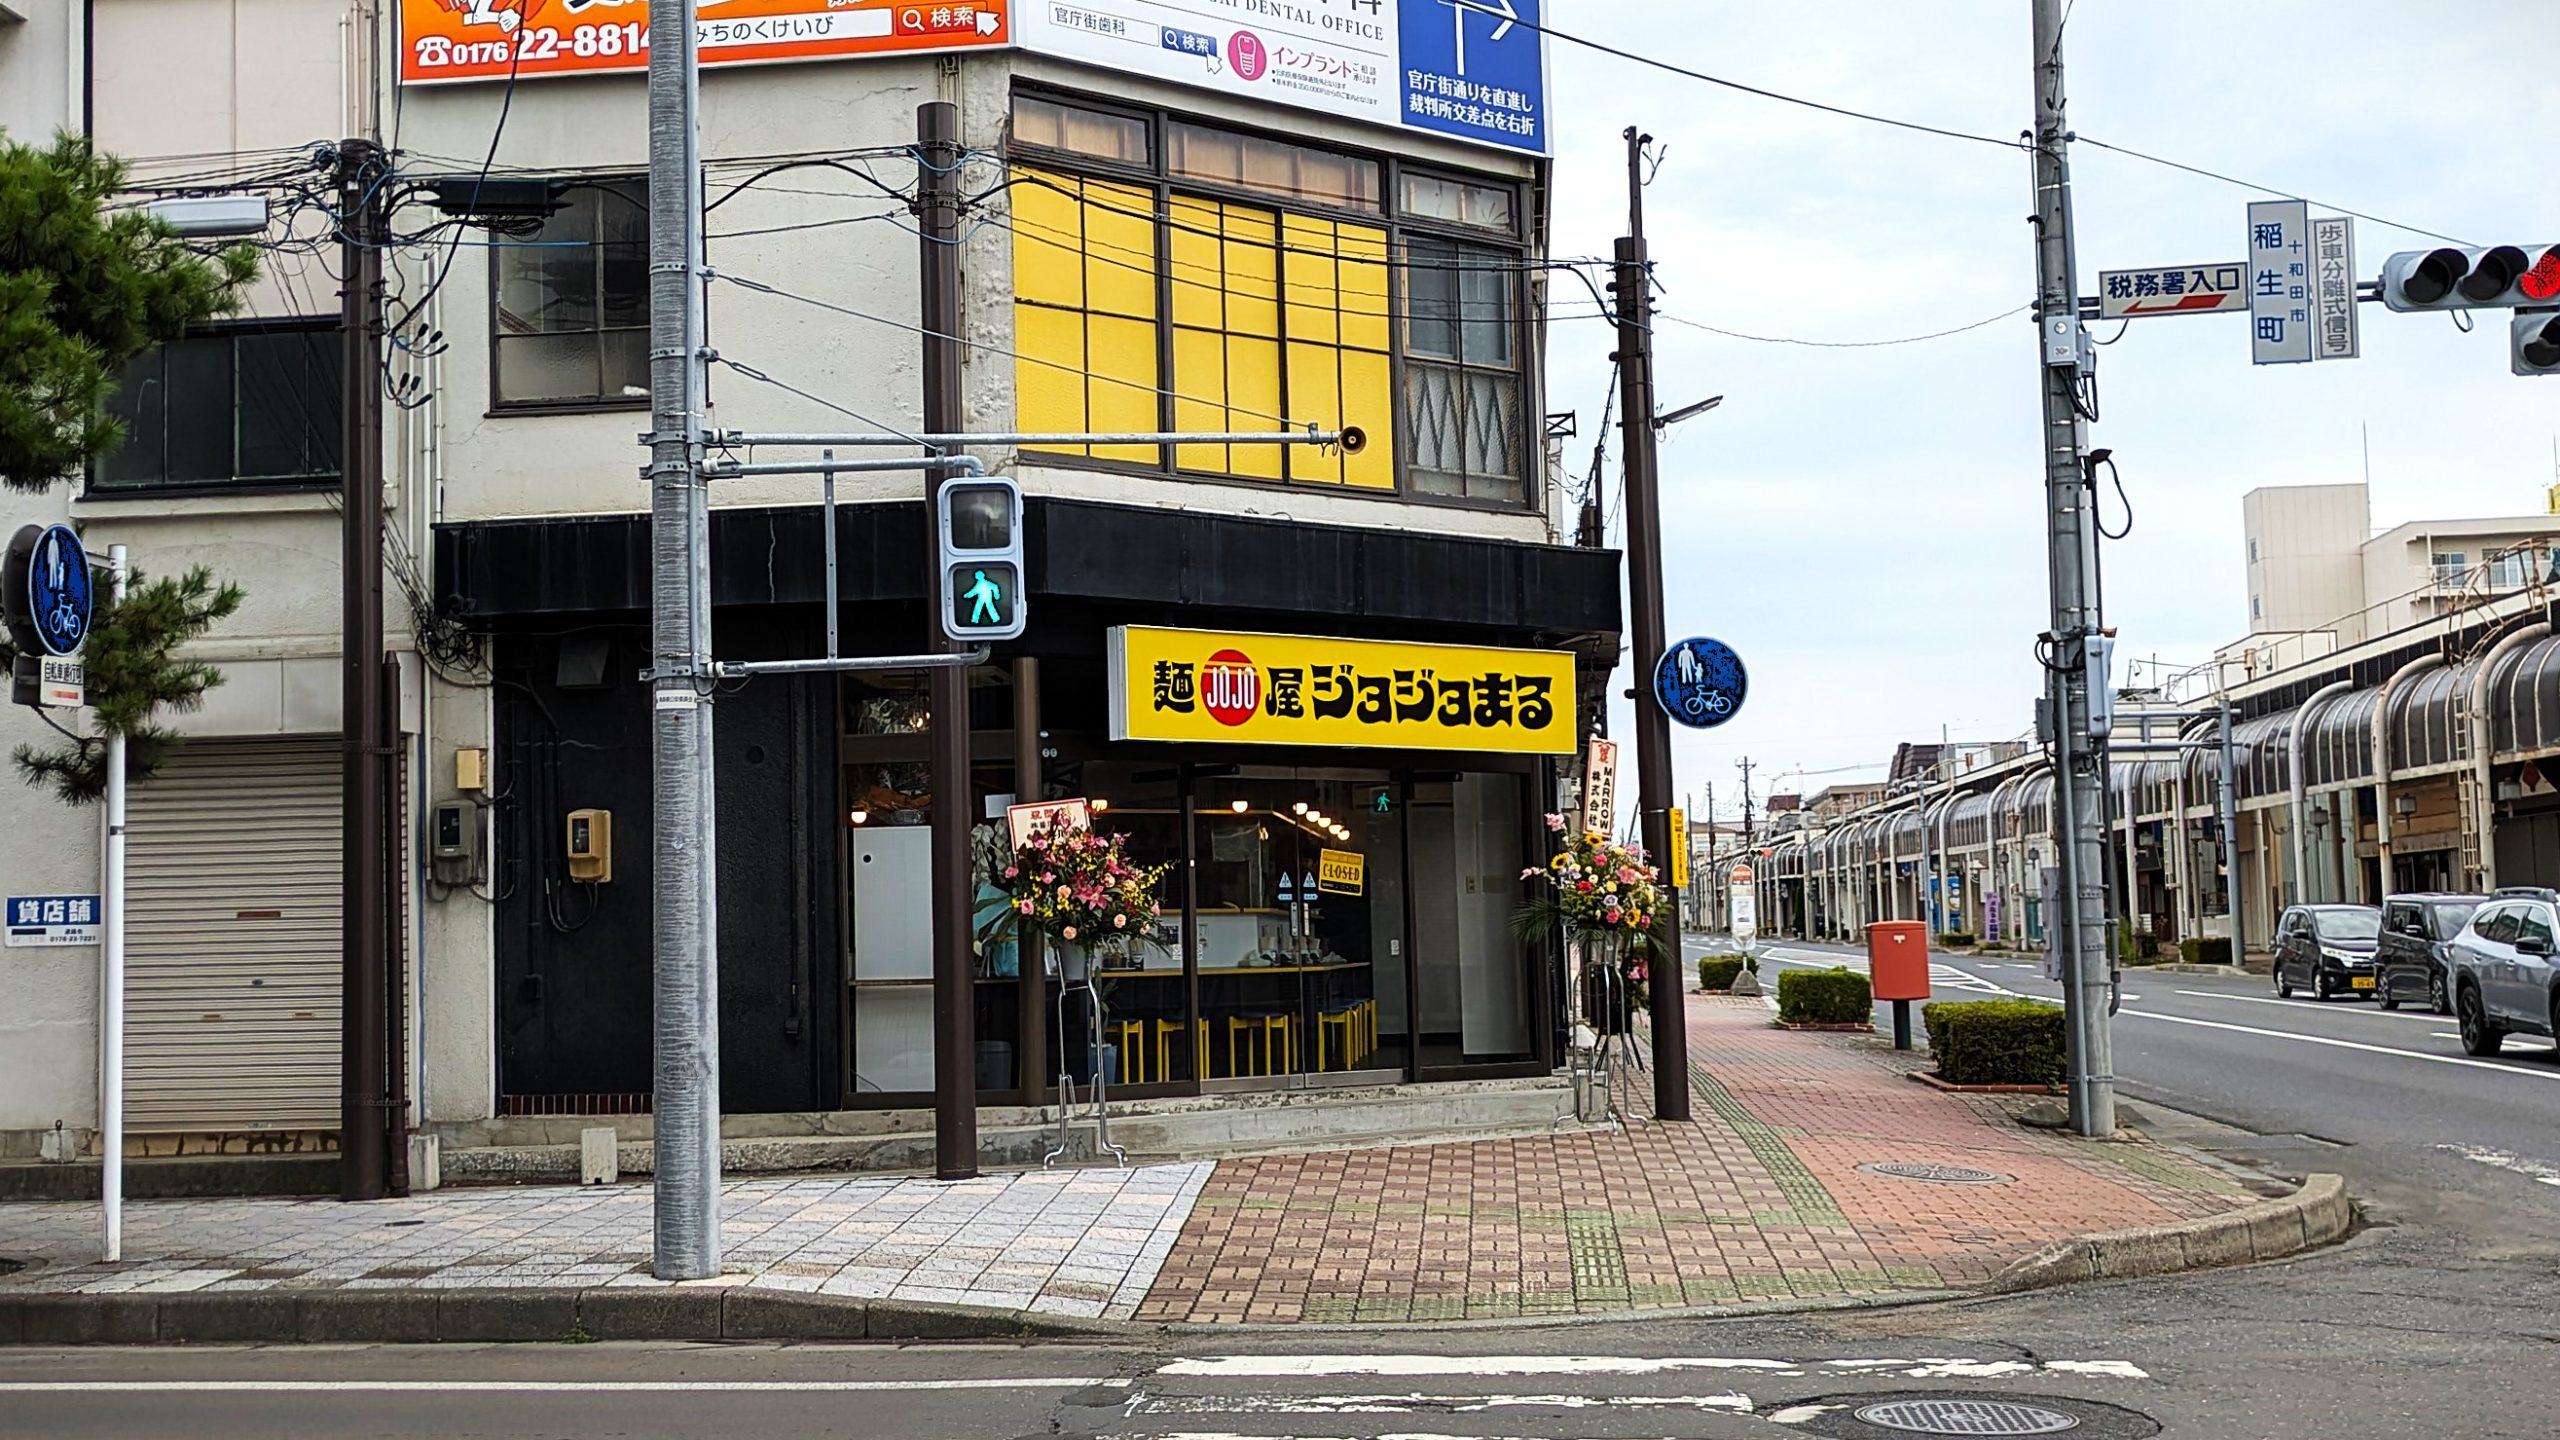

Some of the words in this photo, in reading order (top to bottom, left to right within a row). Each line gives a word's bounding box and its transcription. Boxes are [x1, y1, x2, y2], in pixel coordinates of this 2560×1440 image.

[930, 7, 975, 28] 検索
[1055, 7, 1125, 36] 官庁街歯科
[1246, 0, 1315, 25] DENTAL
[1322, 14, 1384, 41] OFFICE
[452, 41, 508, 65] 0176
[1182, 33, 1210, 53] 検索
[1272, 46, 1352, 79] インプラント
[1407, 69, 1534, 113] 官庁街通りを直進し
[1409, 93, 1535, 137] 裁判所交差点を右折
[2107, 268, 2240, 300] 税務署入口
[2254, 222, 2285, 343] 稲生町
[2288, 239, 2305, 323] 十和田市
[2319, 225, 2349, 353] 歩車分離式信号
[1588, 770, 1601, 827] 株式会社
[1600, 766, 1613, 830] MARROW
[1323, 863, 1360, 881] CLOSED
[17, 899, 92, 924] 貸店舗
